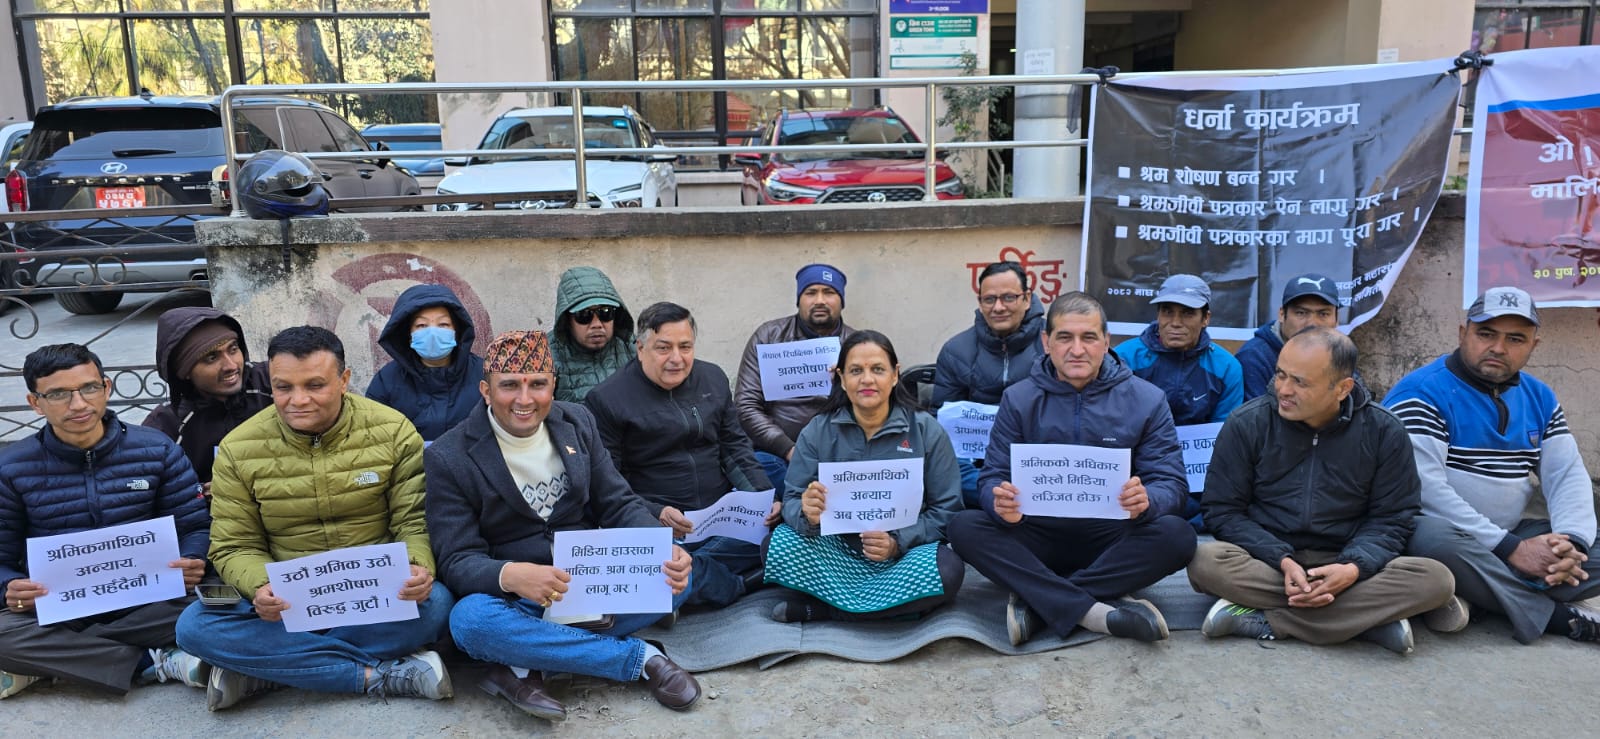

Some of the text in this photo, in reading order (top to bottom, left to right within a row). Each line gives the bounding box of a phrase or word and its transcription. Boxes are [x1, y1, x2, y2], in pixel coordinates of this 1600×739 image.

[1184, 102, 1360, 130] धर्ना कार्यक्रम
[1538, 134, 1574, 163] ओ
[1140, 166, 1168, 183] श्रम
[1174, 166, 1222, 186] शोषण
[1226, 171, 1262, 187] बन्द
[1268, 170, 1298, 186] गर
[1530, 174, 1600, 198] मालि
[1140, 195, 1204, 215] श्रमजीवी
[1208, 200, 1268, 216] पत्रकार
[1275, 196, 1302, 216] ऐन
[1309, 198, 1348, 217] लागु
[1355, 192, 1384, 211] गर
[1138, 224, 1202, 245] श्रमजीवी
[1208, 228, 1290, 247] पत्रकारका
[1295, 228, 1334, 246] माग
[1340, 222, 1374, 247] पूरा
[1376, 212, 1405, 232] गर
[1020, 456, 1120, 472] श्रमिकको अधिकार
[832, 468, 910, 483] श्रमिकमाथिको
[850, 490, 892, 500] अन्याय
[833, 510, 852, 520] अब
[46, 530, 156, 562] श्रमिकमाथिको
[571, 545, 654, 558] मिडिया हाउसका
[314, 560, 361, 577] श्रमिक
[606, 565, 626, 575] श्रम
[629, 564, 662, 576] कानून
[59, 587, 86, 602] अब
[309, 578, 379, 598] श्रमशोषण
[585, 584, 611, 595] लागू
[613, 584, 630, 593] गर
